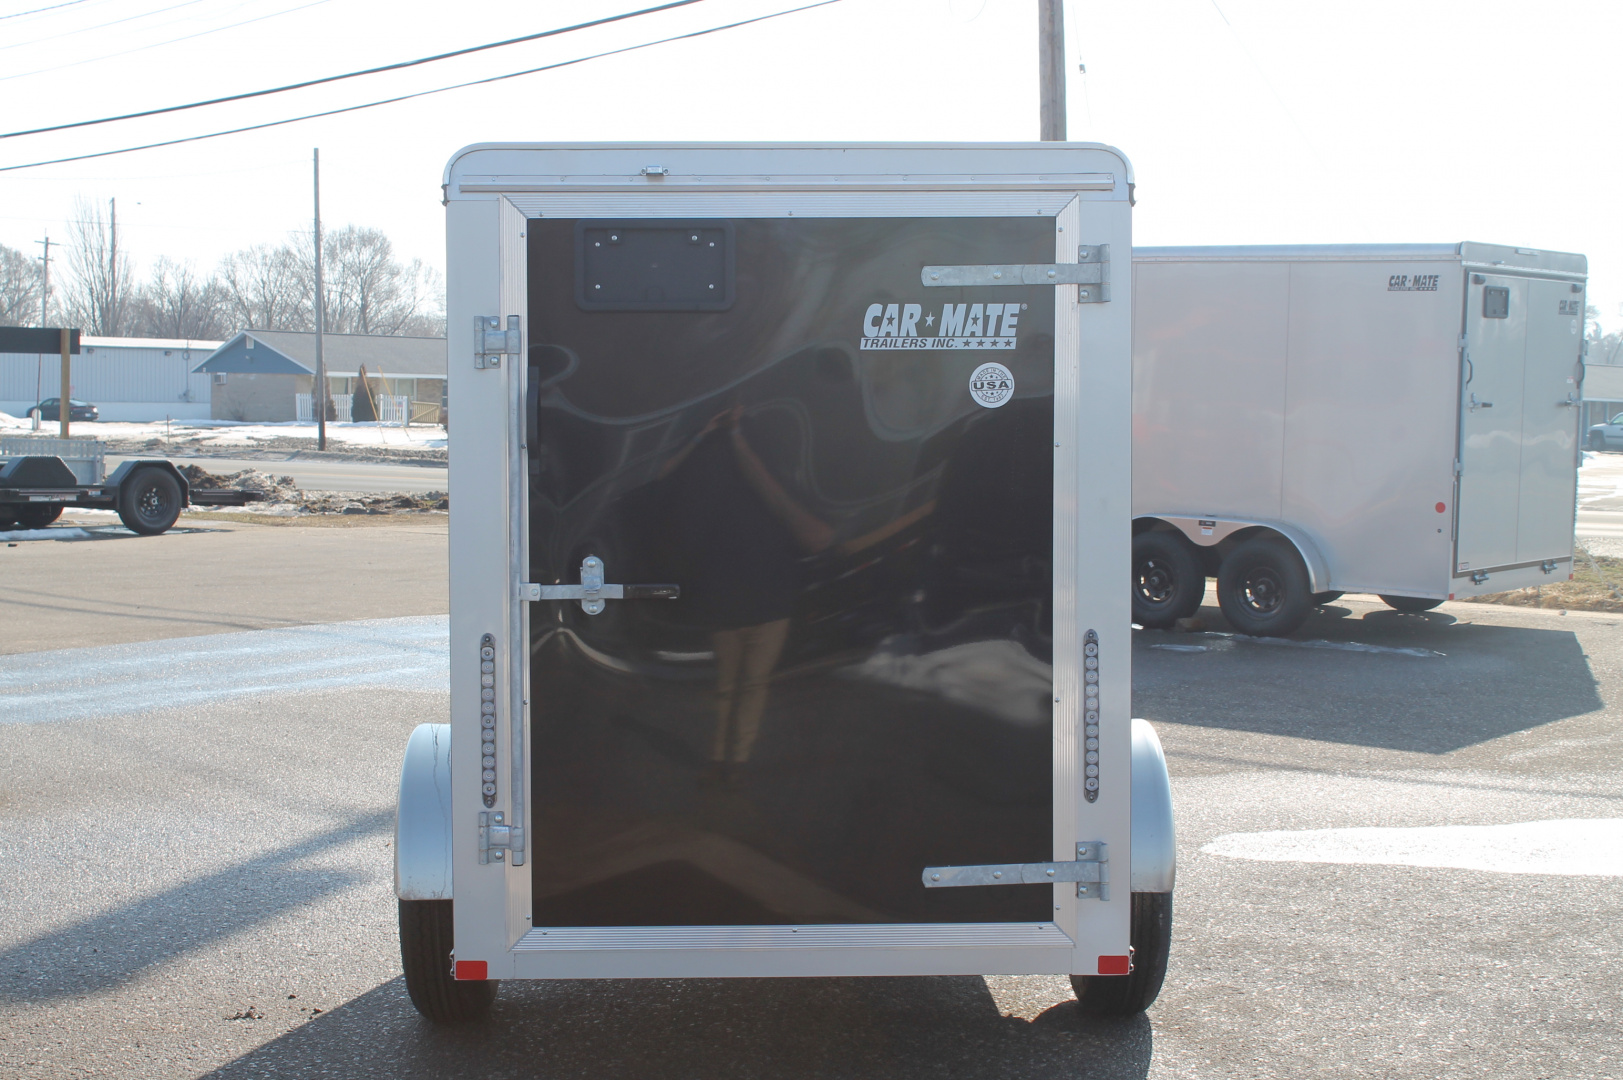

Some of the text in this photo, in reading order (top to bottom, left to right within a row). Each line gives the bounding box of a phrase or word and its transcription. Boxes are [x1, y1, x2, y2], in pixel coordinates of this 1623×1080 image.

[1388, 275, 1439, 287] CAR MATE
[863, 303, 1021, 338] CAR MATE
[863, 338, 958, 348] TRAILERS INC.
[973, 380, 1010, 390] USA
